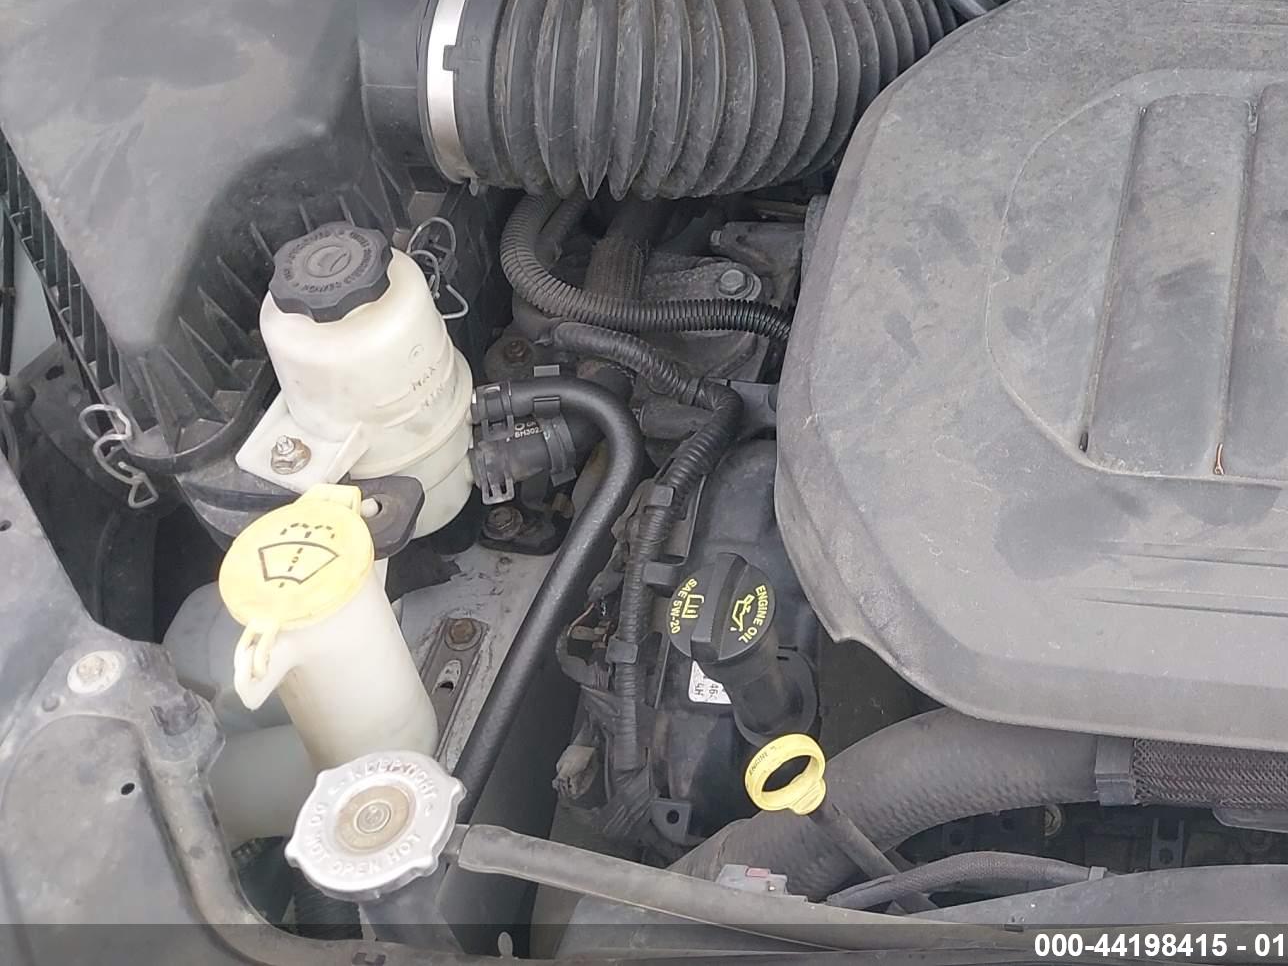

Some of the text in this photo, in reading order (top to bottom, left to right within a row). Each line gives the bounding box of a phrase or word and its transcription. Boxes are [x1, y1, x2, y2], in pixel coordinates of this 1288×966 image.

[669, 578, 698, 634] SAE 5W-20
[738, 584, 769, 644] ENGINE OIL
[387, 832, 422, 866] HOT
